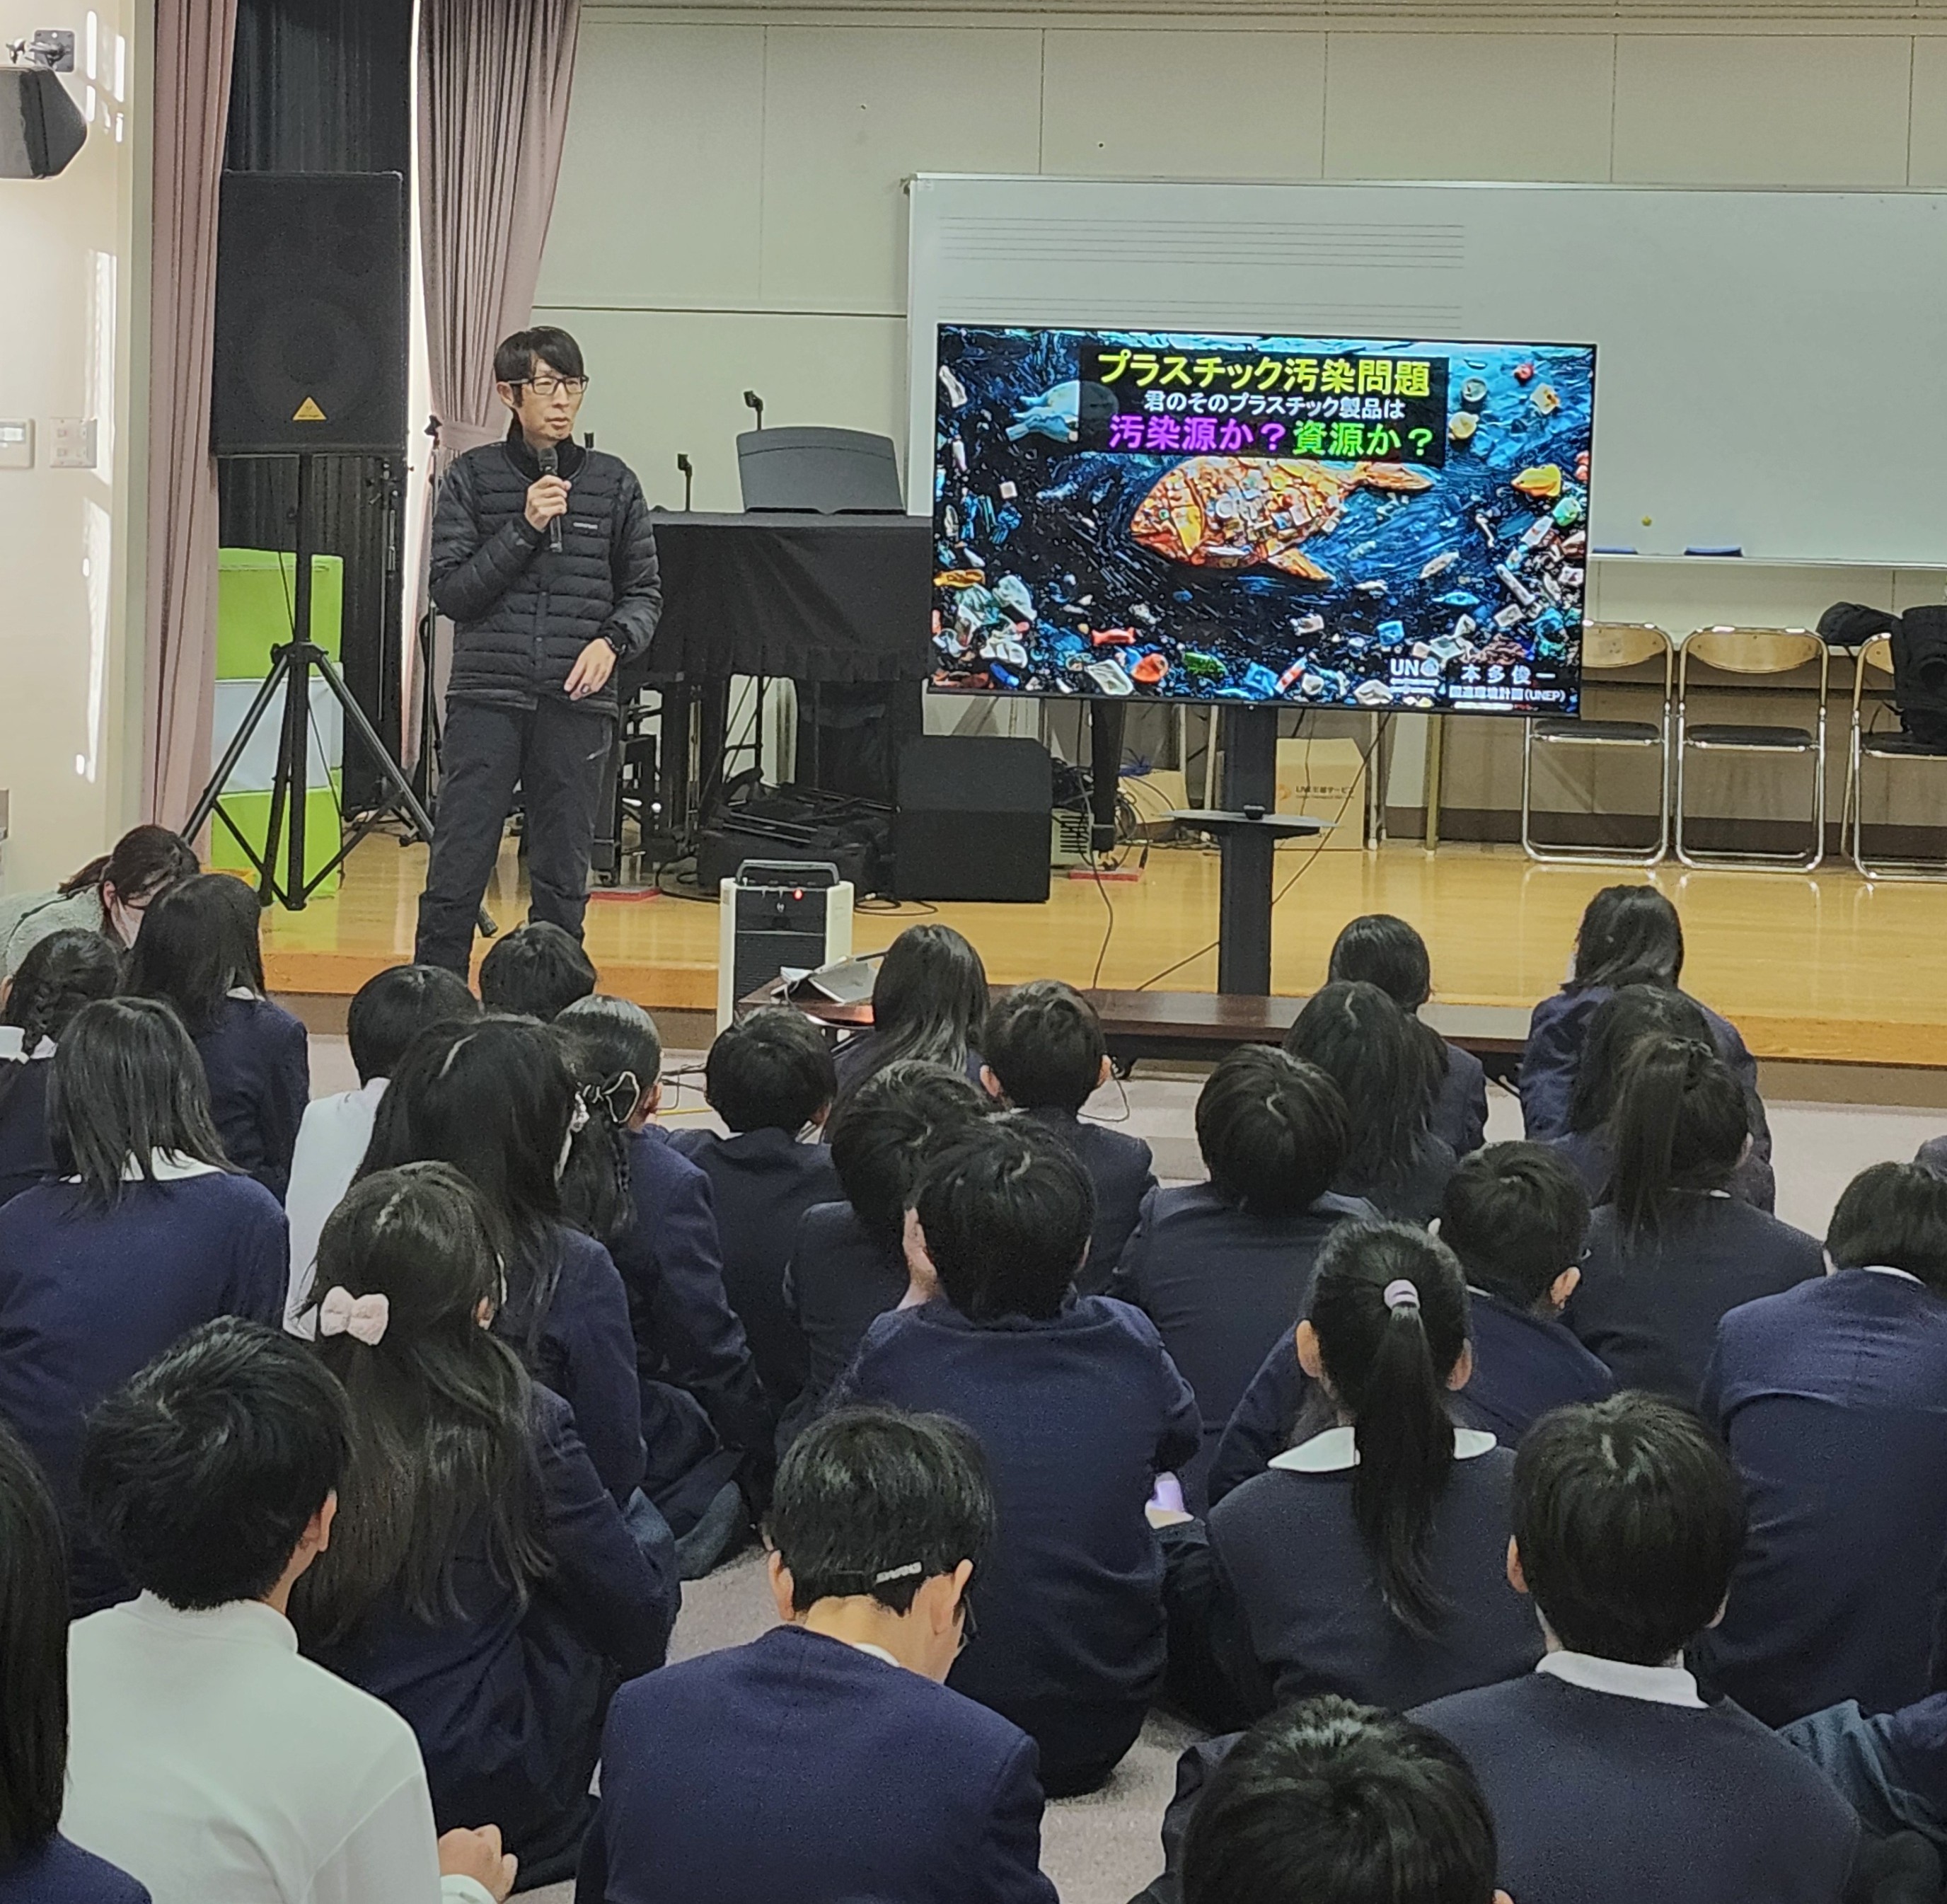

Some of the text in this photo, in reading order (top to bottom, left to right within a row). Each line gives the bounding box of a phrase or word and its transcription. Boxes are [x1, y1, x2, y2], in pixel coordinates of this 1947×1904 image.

[1097, 350, 1430, 397] プラスチック汚染問題
[1144, 390, 1406, 420] 君のそのプラスチック製品は
